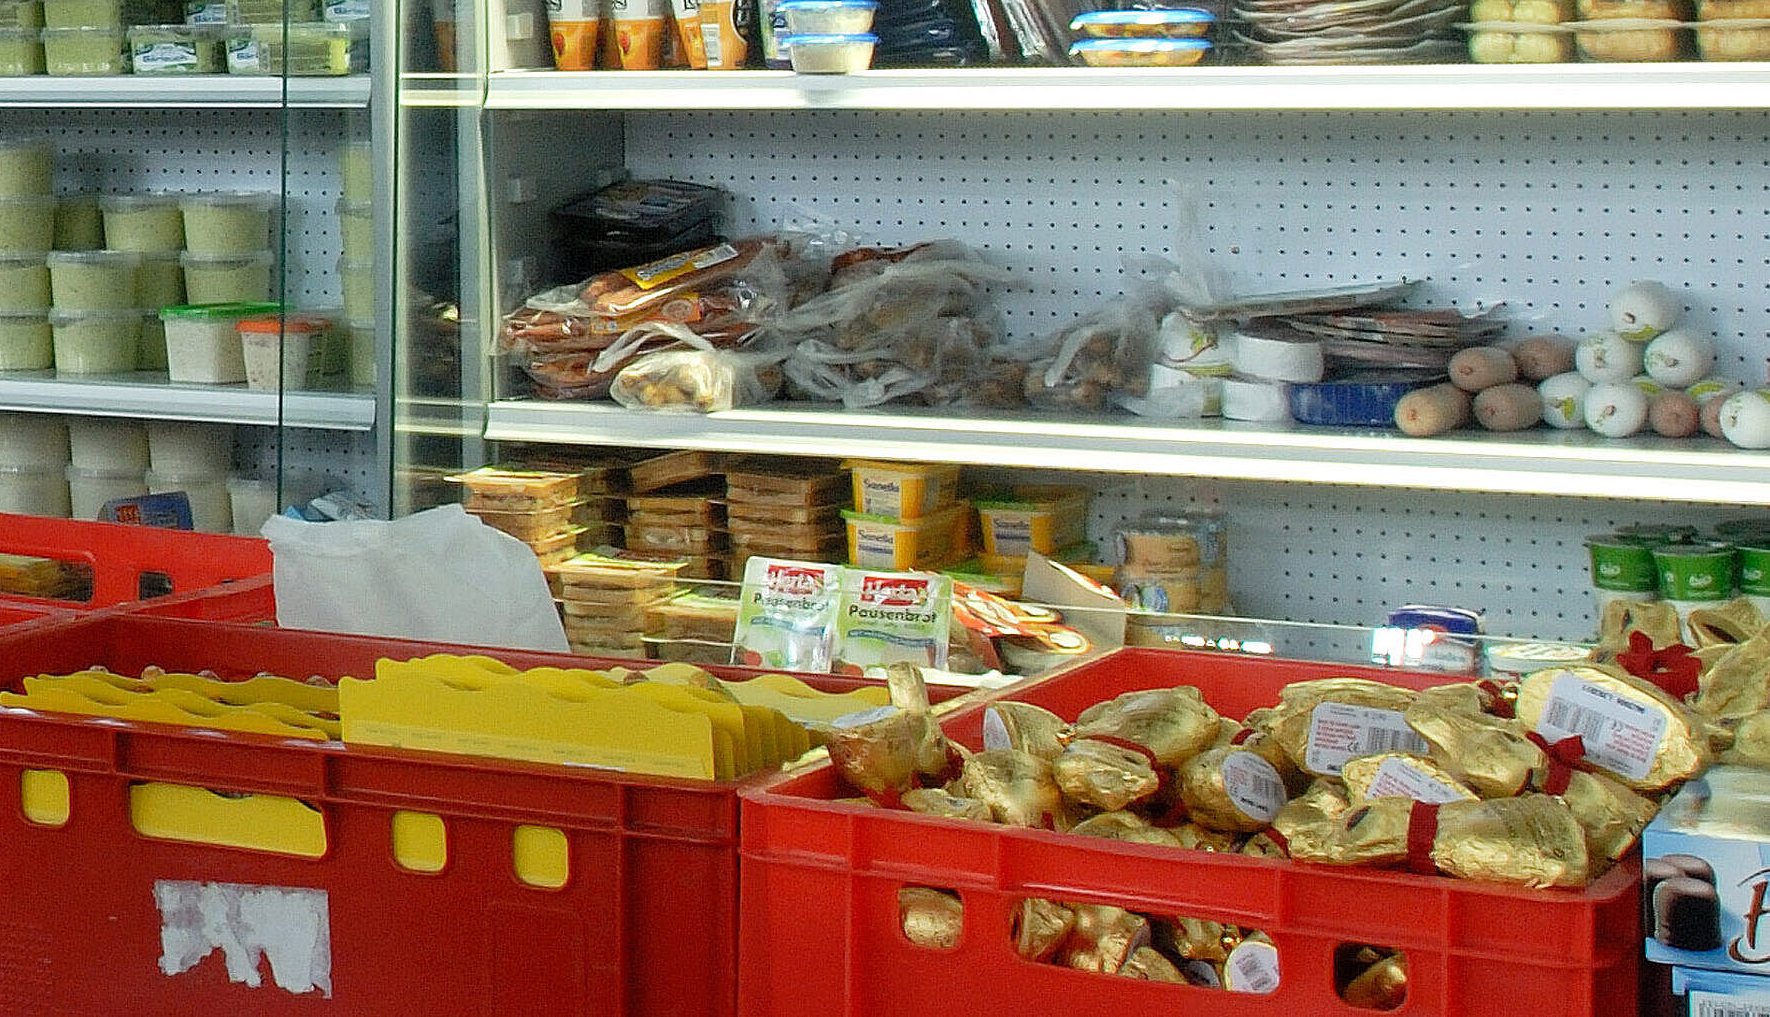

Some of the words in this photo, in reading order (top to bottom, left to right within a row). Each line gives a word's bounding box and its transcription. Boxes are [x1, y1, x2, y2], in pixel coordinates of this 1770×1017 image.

[753, 592, 830, 612] Pausenbrot
[863, 578, 927, 606] Herta
[848, 604, 938, 623] Pausenbrot
